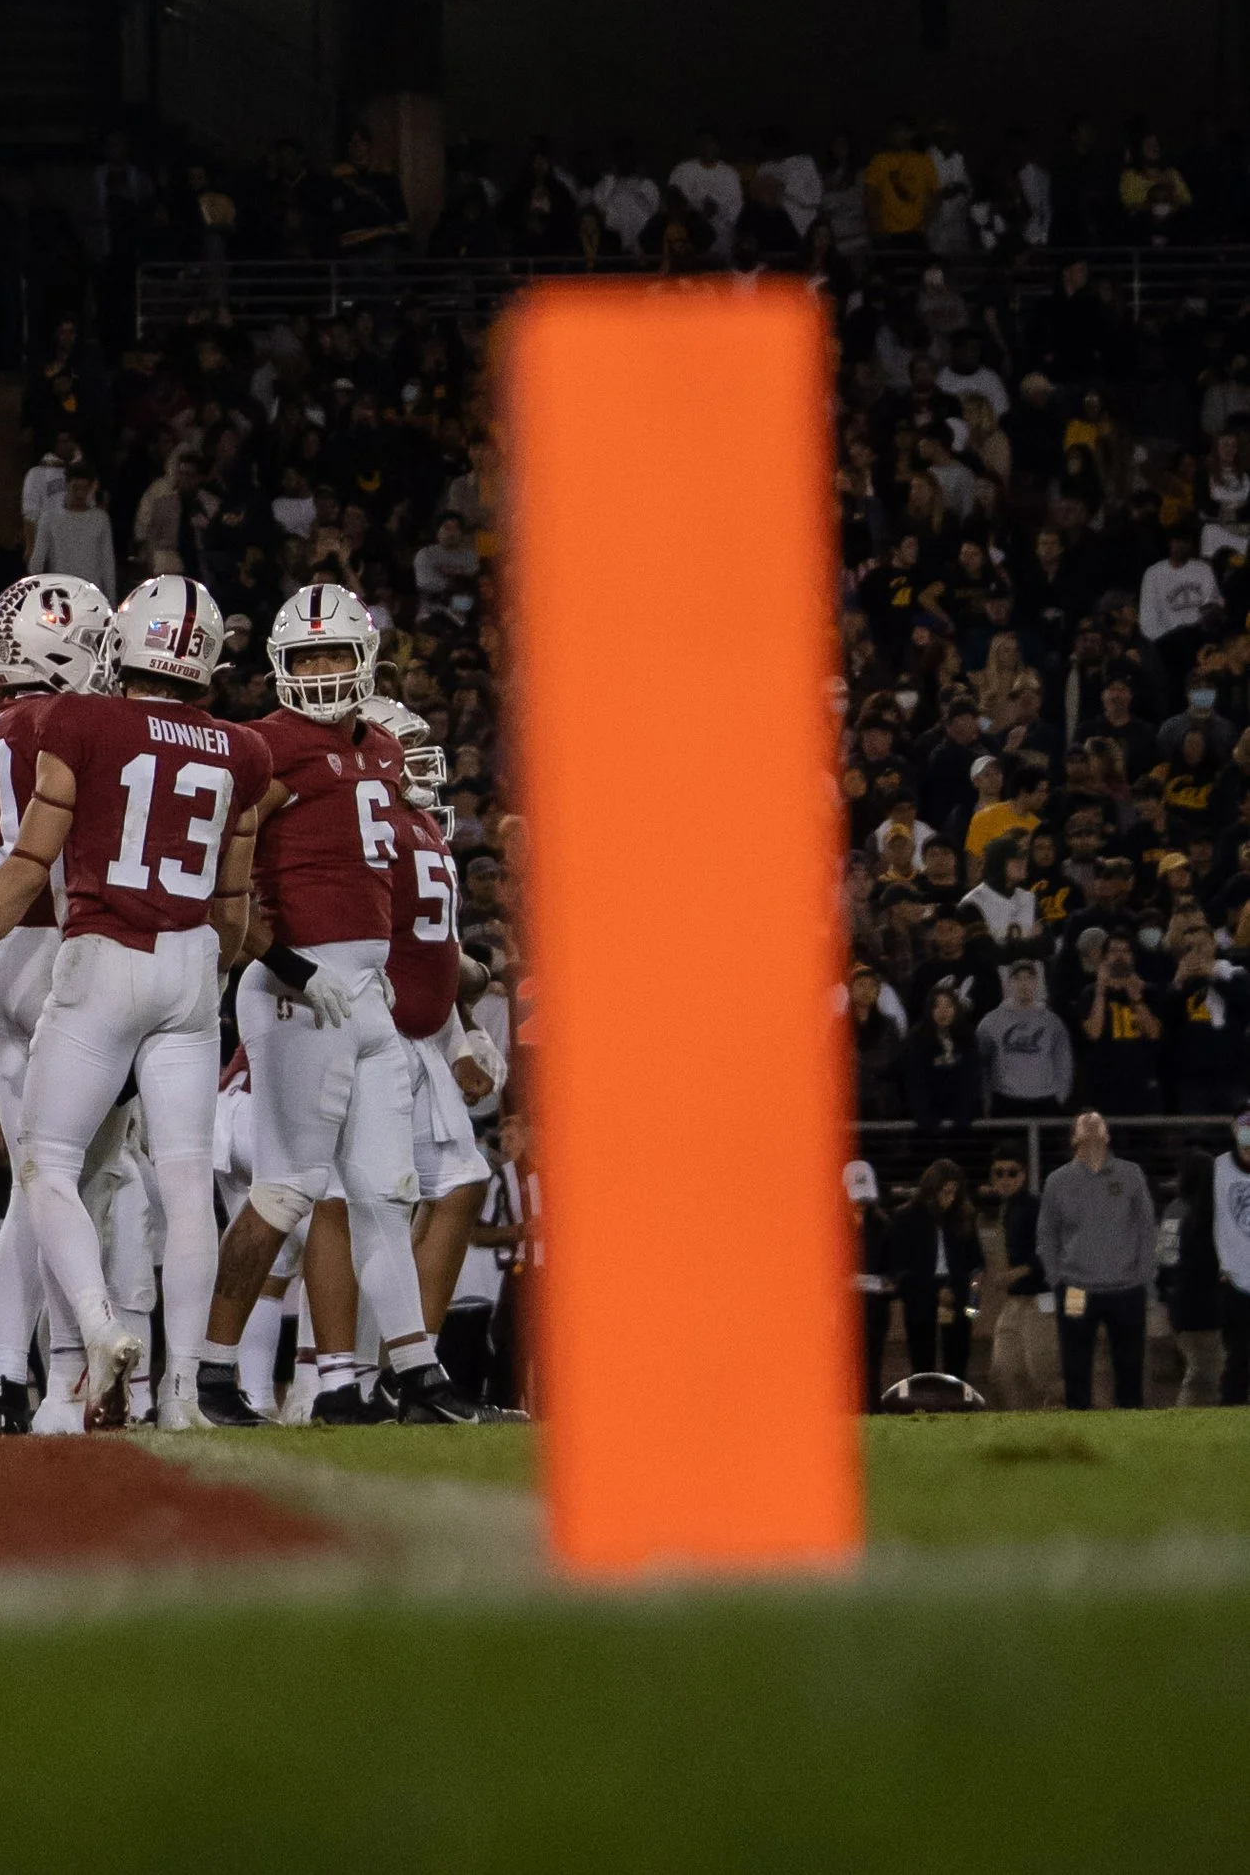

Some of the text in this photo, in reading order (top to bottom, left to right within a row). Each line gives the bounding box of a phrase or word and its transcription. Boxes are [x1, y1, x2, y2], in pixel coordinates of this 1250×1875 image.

[149, 658, 201, 680] STANFORD
[147, 715, 230, 757] BONNER
[106, 753, 234, 901] 13
[355, 780, 399, 869] 6
[1002, 1021, 1045, 1055] Cal
